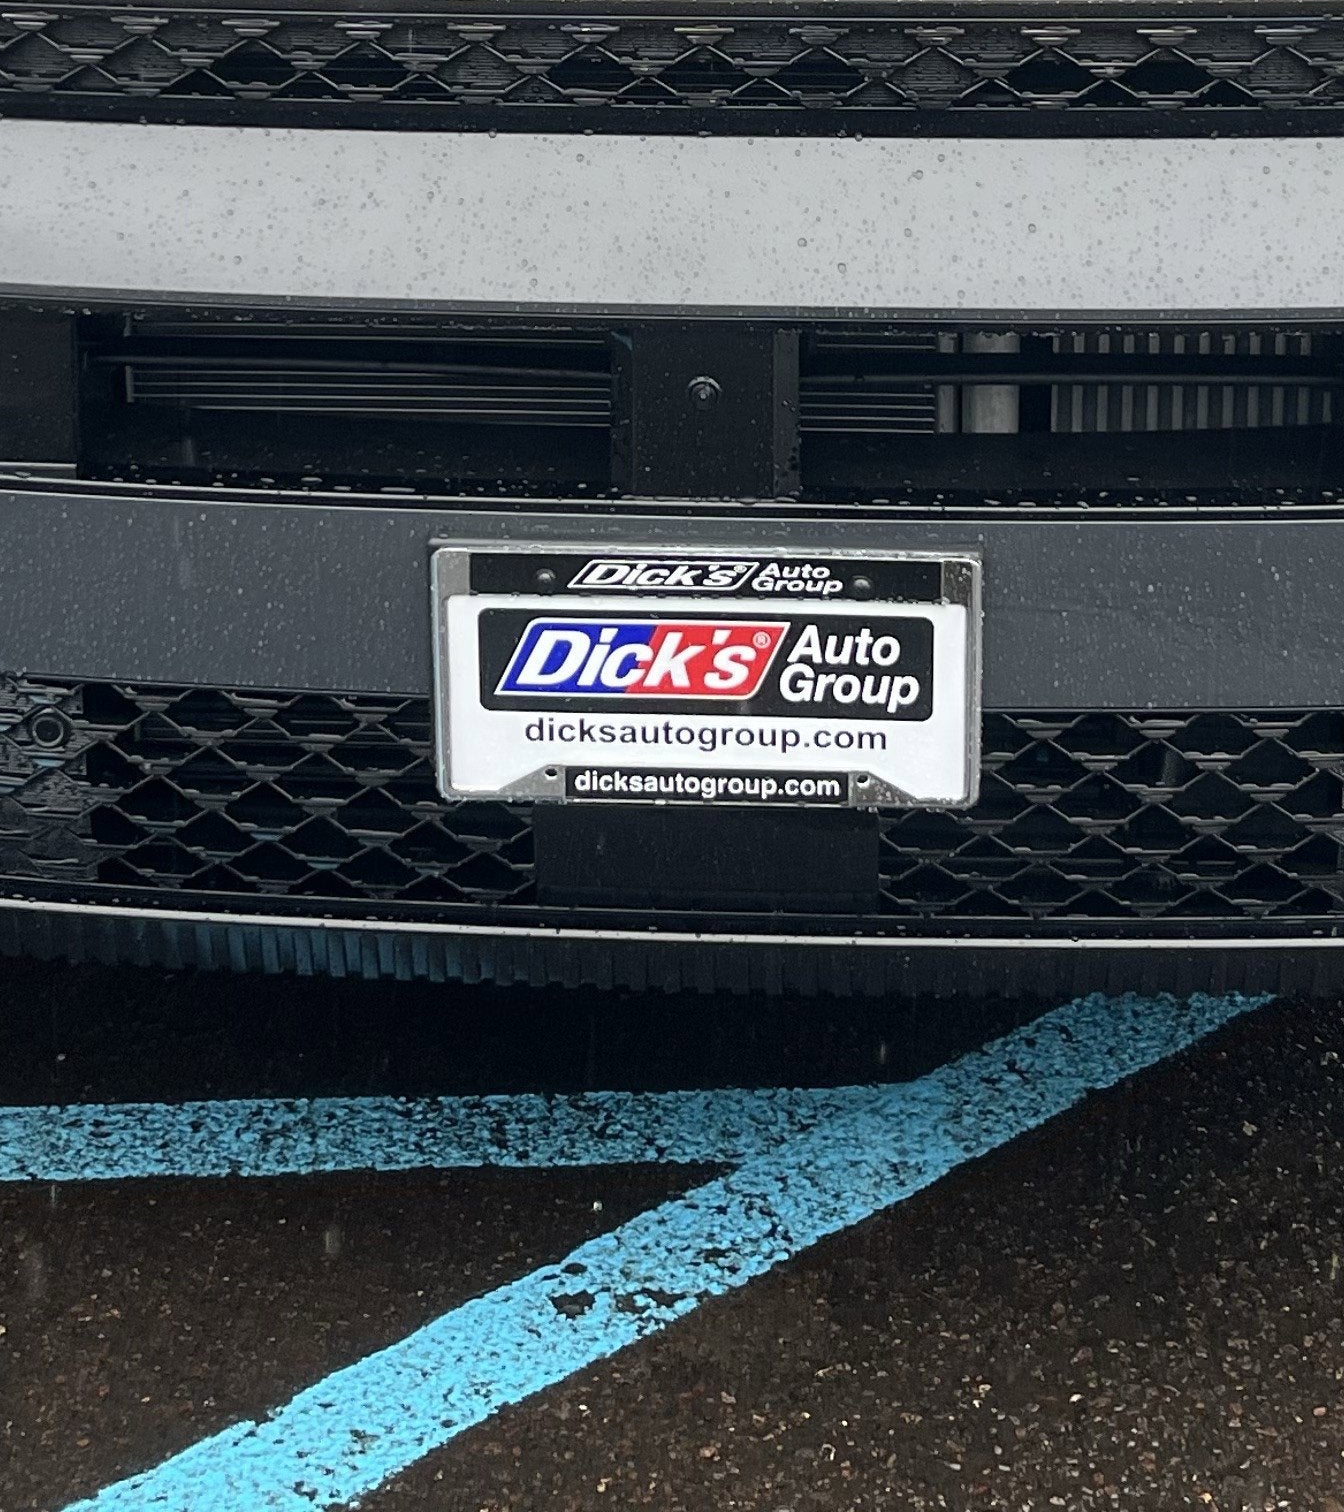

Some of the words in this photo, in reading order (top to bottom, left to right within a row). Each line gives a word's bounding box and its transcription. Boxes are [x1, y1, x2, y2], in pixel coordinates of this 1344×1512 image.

[751, 577, 844, 594] Group
[758, 563, 831, 579] Auto
[787, 624, 901, 666] Auto
[779, 663, 920, 713] Group
[524, 717, 887, 753] dicksautogroup.com
[574, 770, 840, 799] dicksautogroup.com
